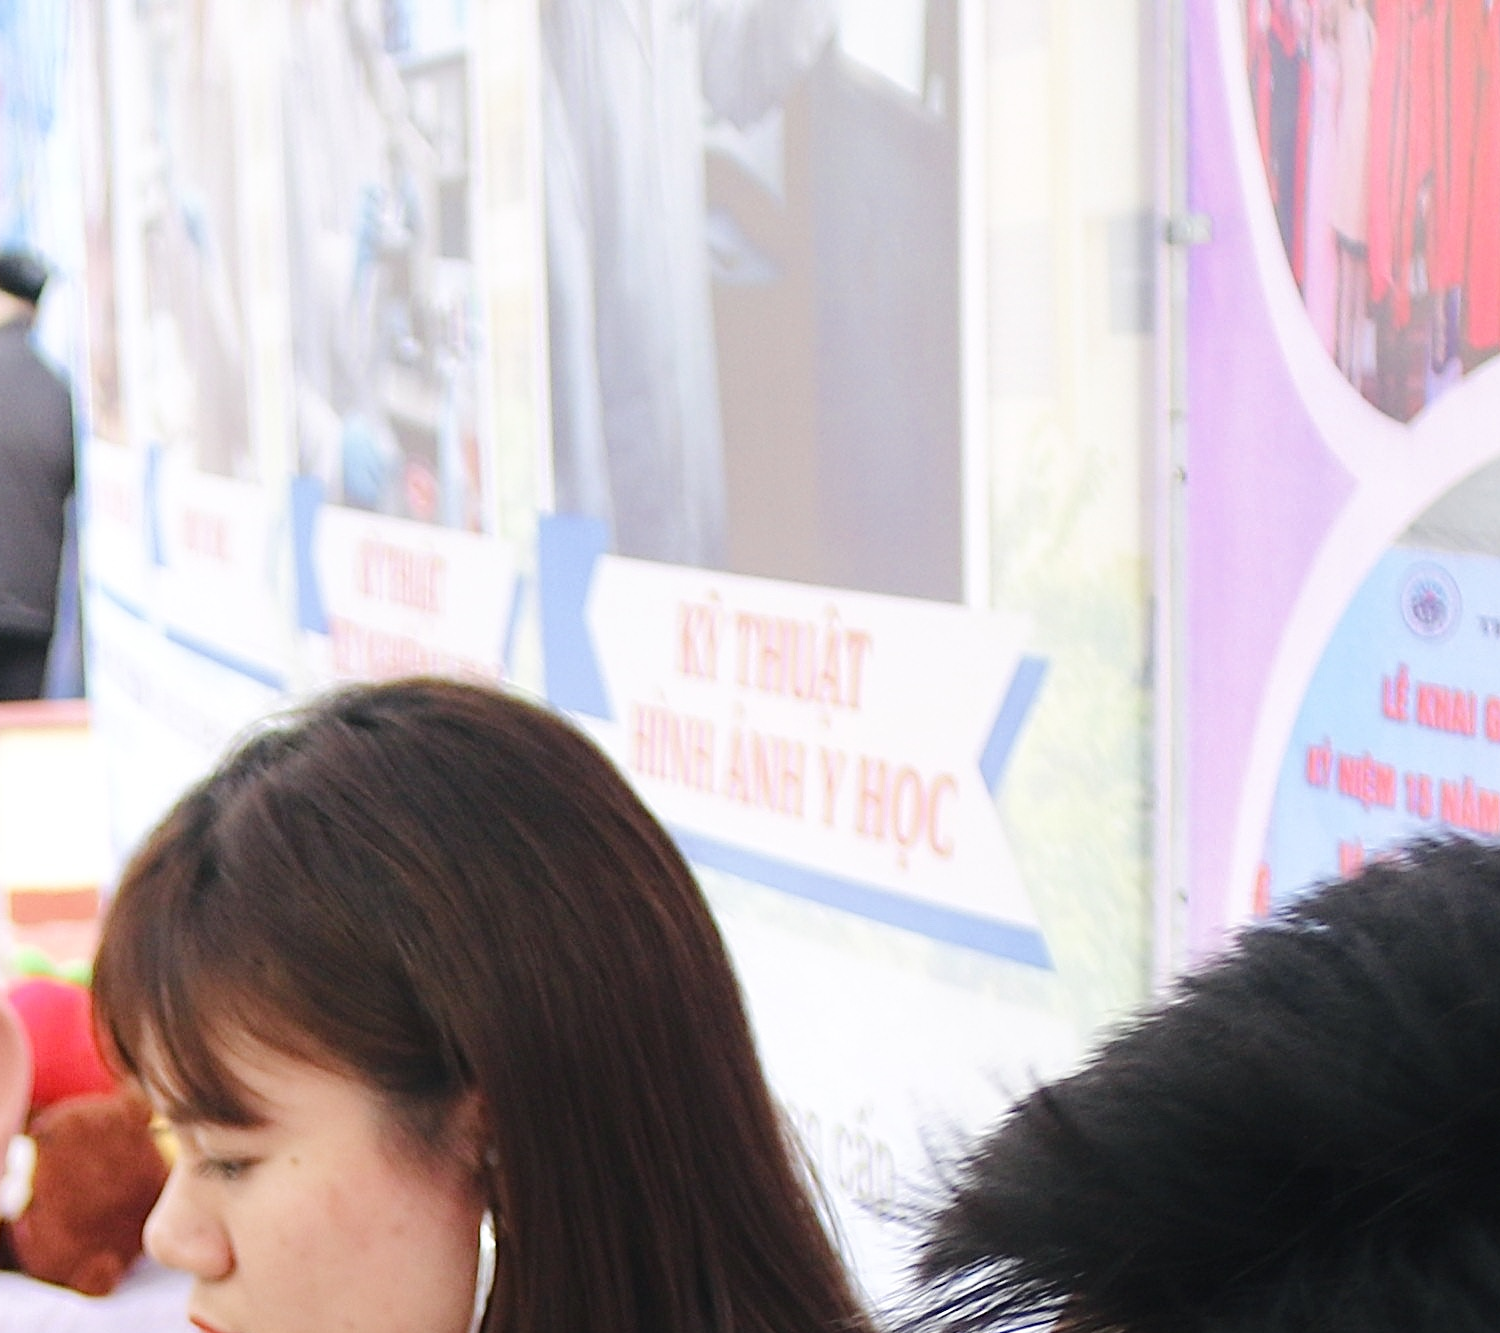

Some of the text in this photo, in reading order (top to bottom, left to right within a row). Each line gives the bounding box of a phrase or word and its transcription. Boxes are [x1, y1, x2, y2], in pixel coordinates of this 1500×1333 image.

[735, 602, 874, 730] THUẬT
[1416, 682, 1477, 737] KHAI
[631, 688, 716, 794] HÌNH
[818, 745, 847, 828] Y
[857, 753, 959, 870] HỌC
[1338, 752, 1397, 811] NIỆM
